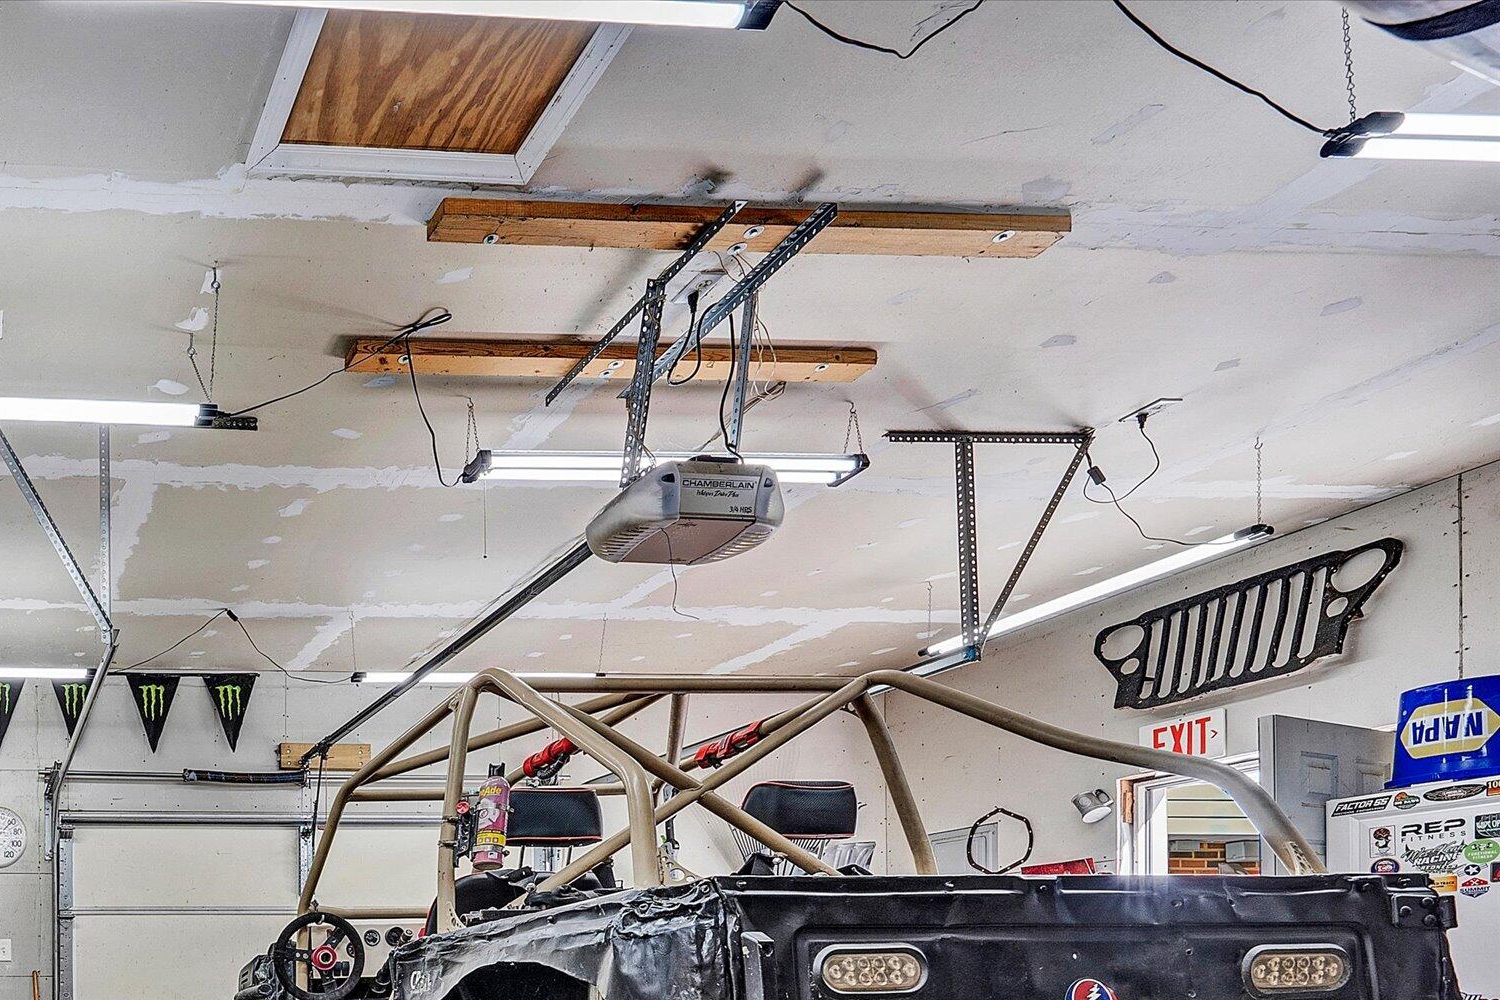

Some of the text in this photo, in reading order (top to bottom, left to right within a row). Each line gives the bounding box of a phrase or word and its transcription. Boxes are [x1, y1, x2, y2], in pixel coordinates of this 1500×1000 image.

[682, 478, 755, 490] CHAMBERLAIN
[1411, 711, 1483, 746] NAPA
[1152, 716, 1211, 755] EXIT
[1335, 800, 1374, 812] FACTOR
[1401, 818, 1465, 838] REP
[1400, 830, 1467, 843] FITNESS
[3, 850, 15, 859] 120
[1459, 885, 1491, 894] SUMMIT
